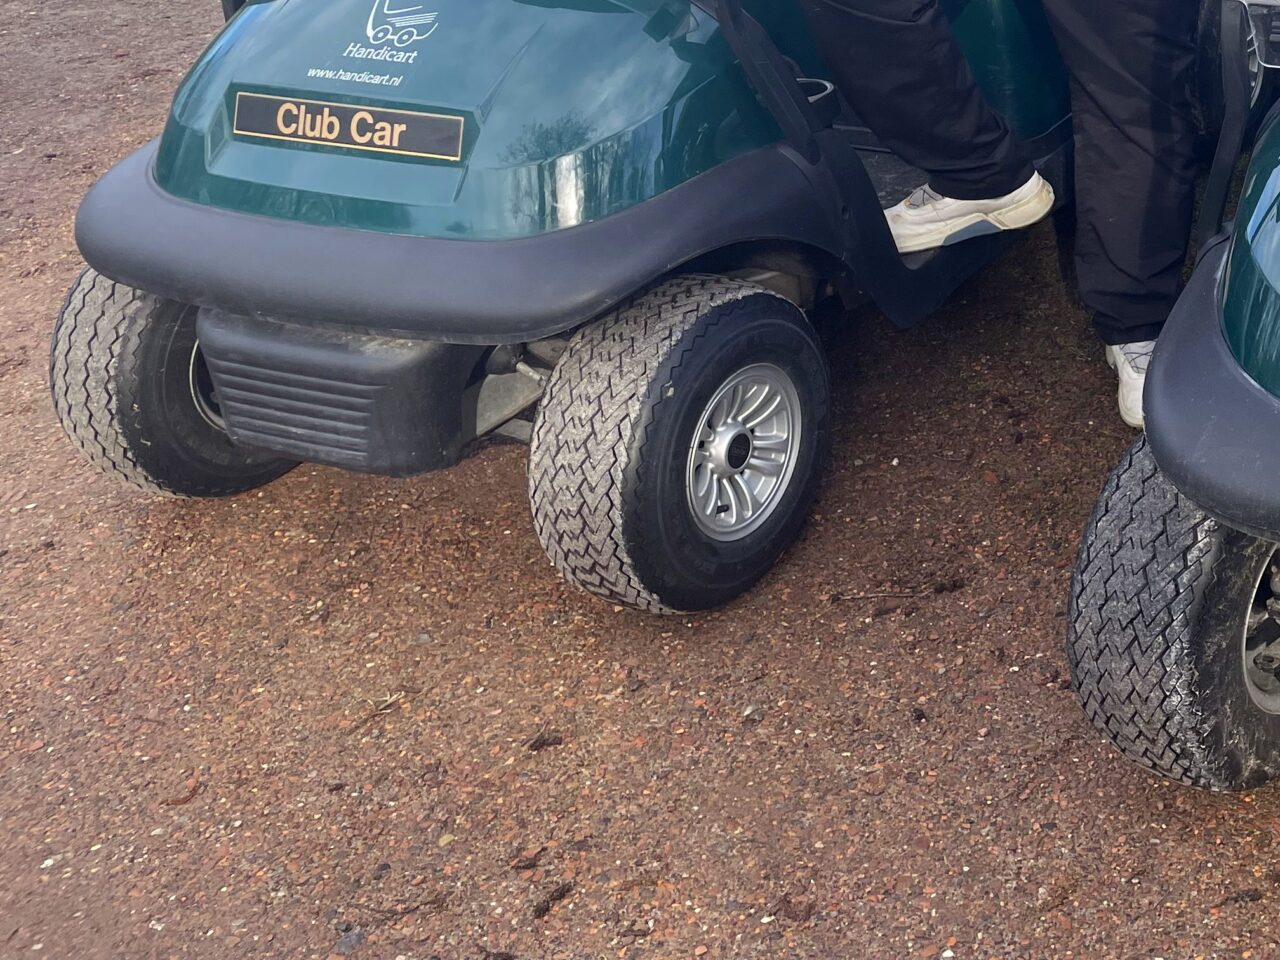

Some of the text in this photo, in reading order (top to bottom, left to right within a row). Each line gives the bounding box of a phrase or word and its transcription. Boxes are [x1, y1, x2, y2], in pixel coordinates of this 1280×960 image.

[343, 42, 418, 64] Handicart
[307, 66, 402, 87] www.handicart.nl
[276, 102, 407, 147] Club Car
